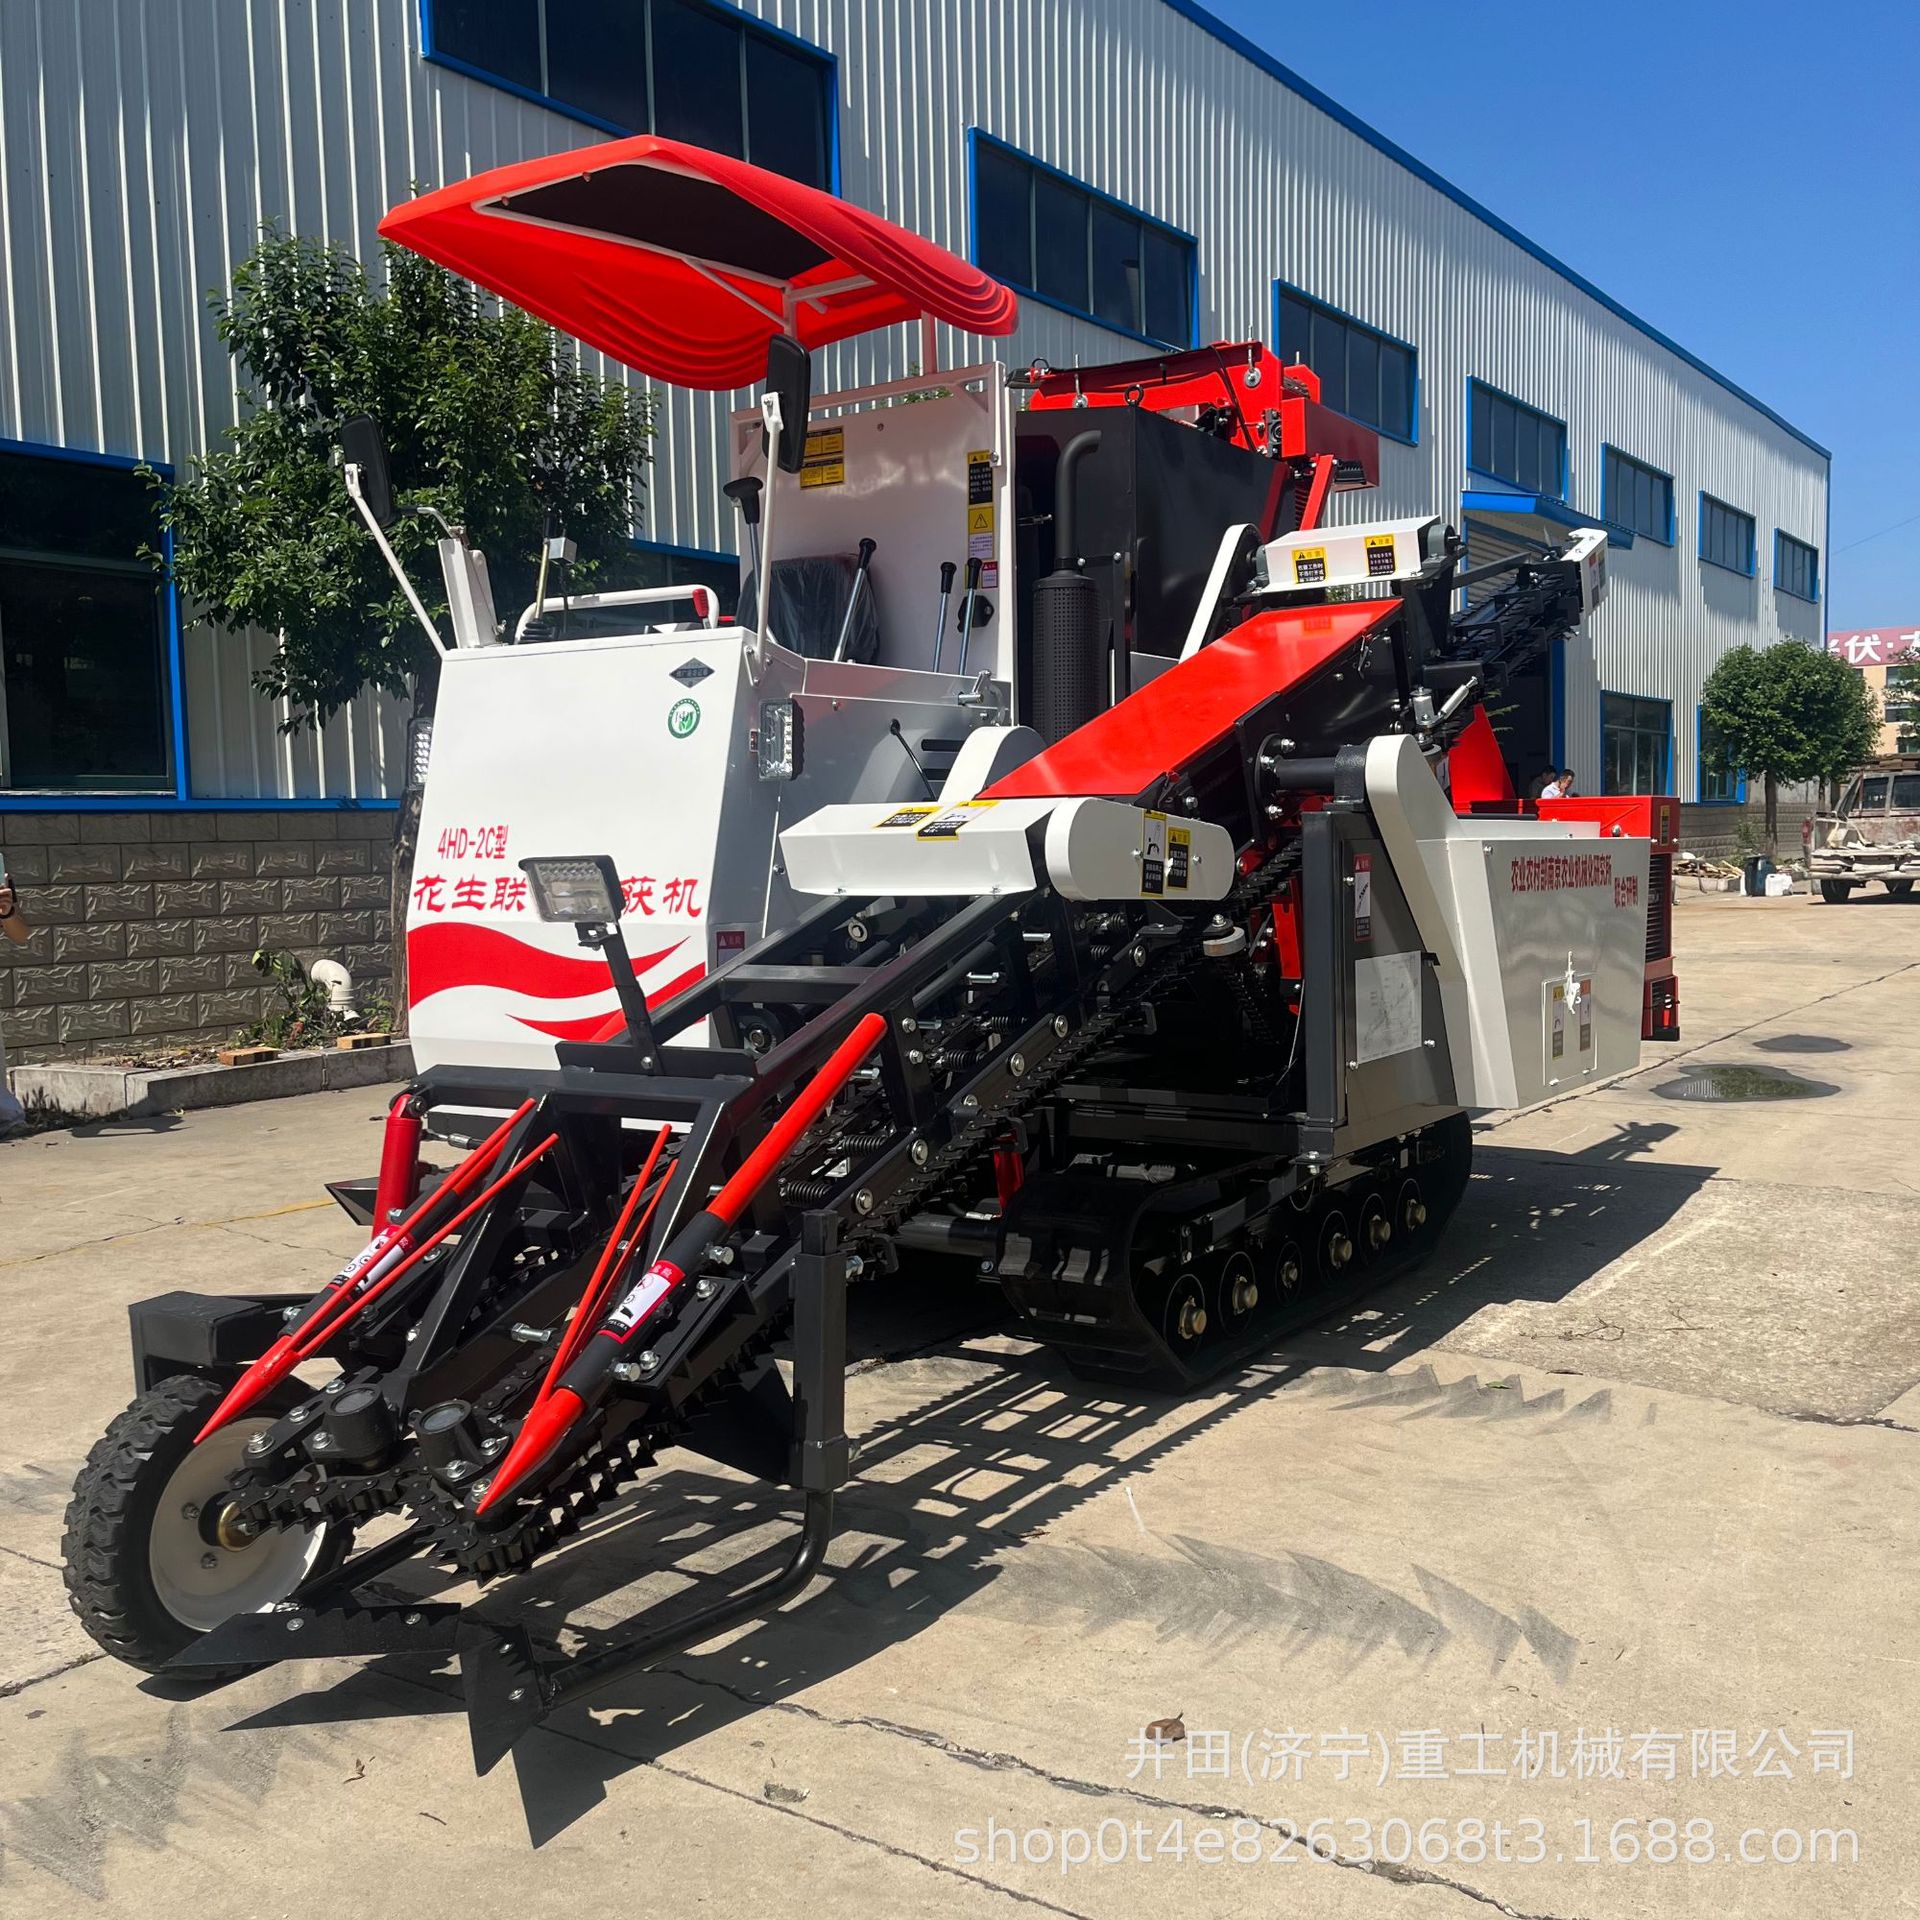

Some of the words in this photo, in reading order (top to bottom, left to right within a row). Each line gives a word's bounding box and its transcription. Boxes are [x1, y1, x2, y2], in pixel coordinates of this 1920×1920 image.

[437, 824, 509, 860] 4HD-2C型
[1511, 854, 1612, 892] 农业农村部南京农业机械化研究所
[1614, 875, 1638, 908] 联合研制
[413, 873, 703, 918] 花生联获机
